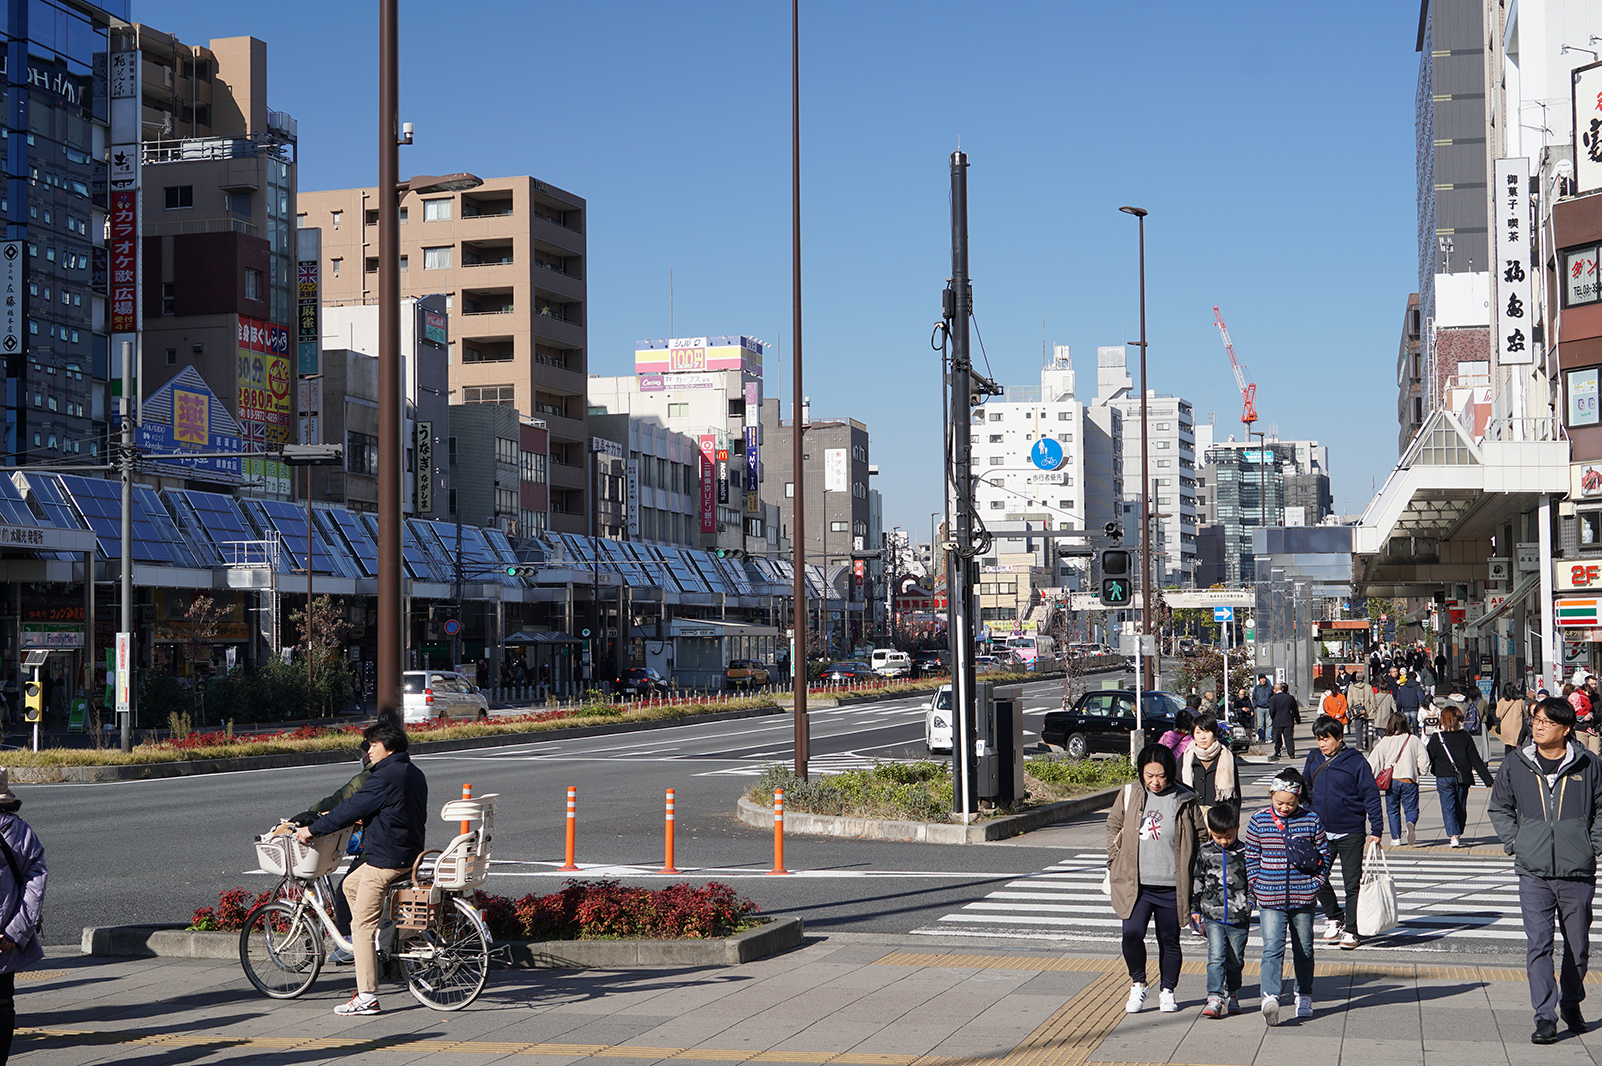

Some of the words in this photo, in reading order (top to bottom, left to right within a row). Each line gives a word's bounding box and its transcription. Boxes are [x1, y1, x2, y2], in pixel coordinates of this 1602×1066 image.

[114, 210, 134, 316] カラオケ歌広場
[1571, 258, 1602, 278] ダン
[299, 283, 318, 291] シェーン
[301, 305, 315, 329] 麻雀
[674, 339, 701, 347] シルク
[671, 348, 704, 369] 100円
[675, 376, 701, 384] カーブス
[178, 393, 205, 442] 薬
[265, 425, 290, 441] シェーン
[419, 424, 431, 471] うなぎ
[1032, 474, 1063, 482] 歩行者優先
[420, 474, 429, 509] ながしま
[703, 462, 713, 527] 三菱東京UFJ銀行
[1571, 565, 1599, 584] 2F
[47, 633, 77, 645] FamilyMart
